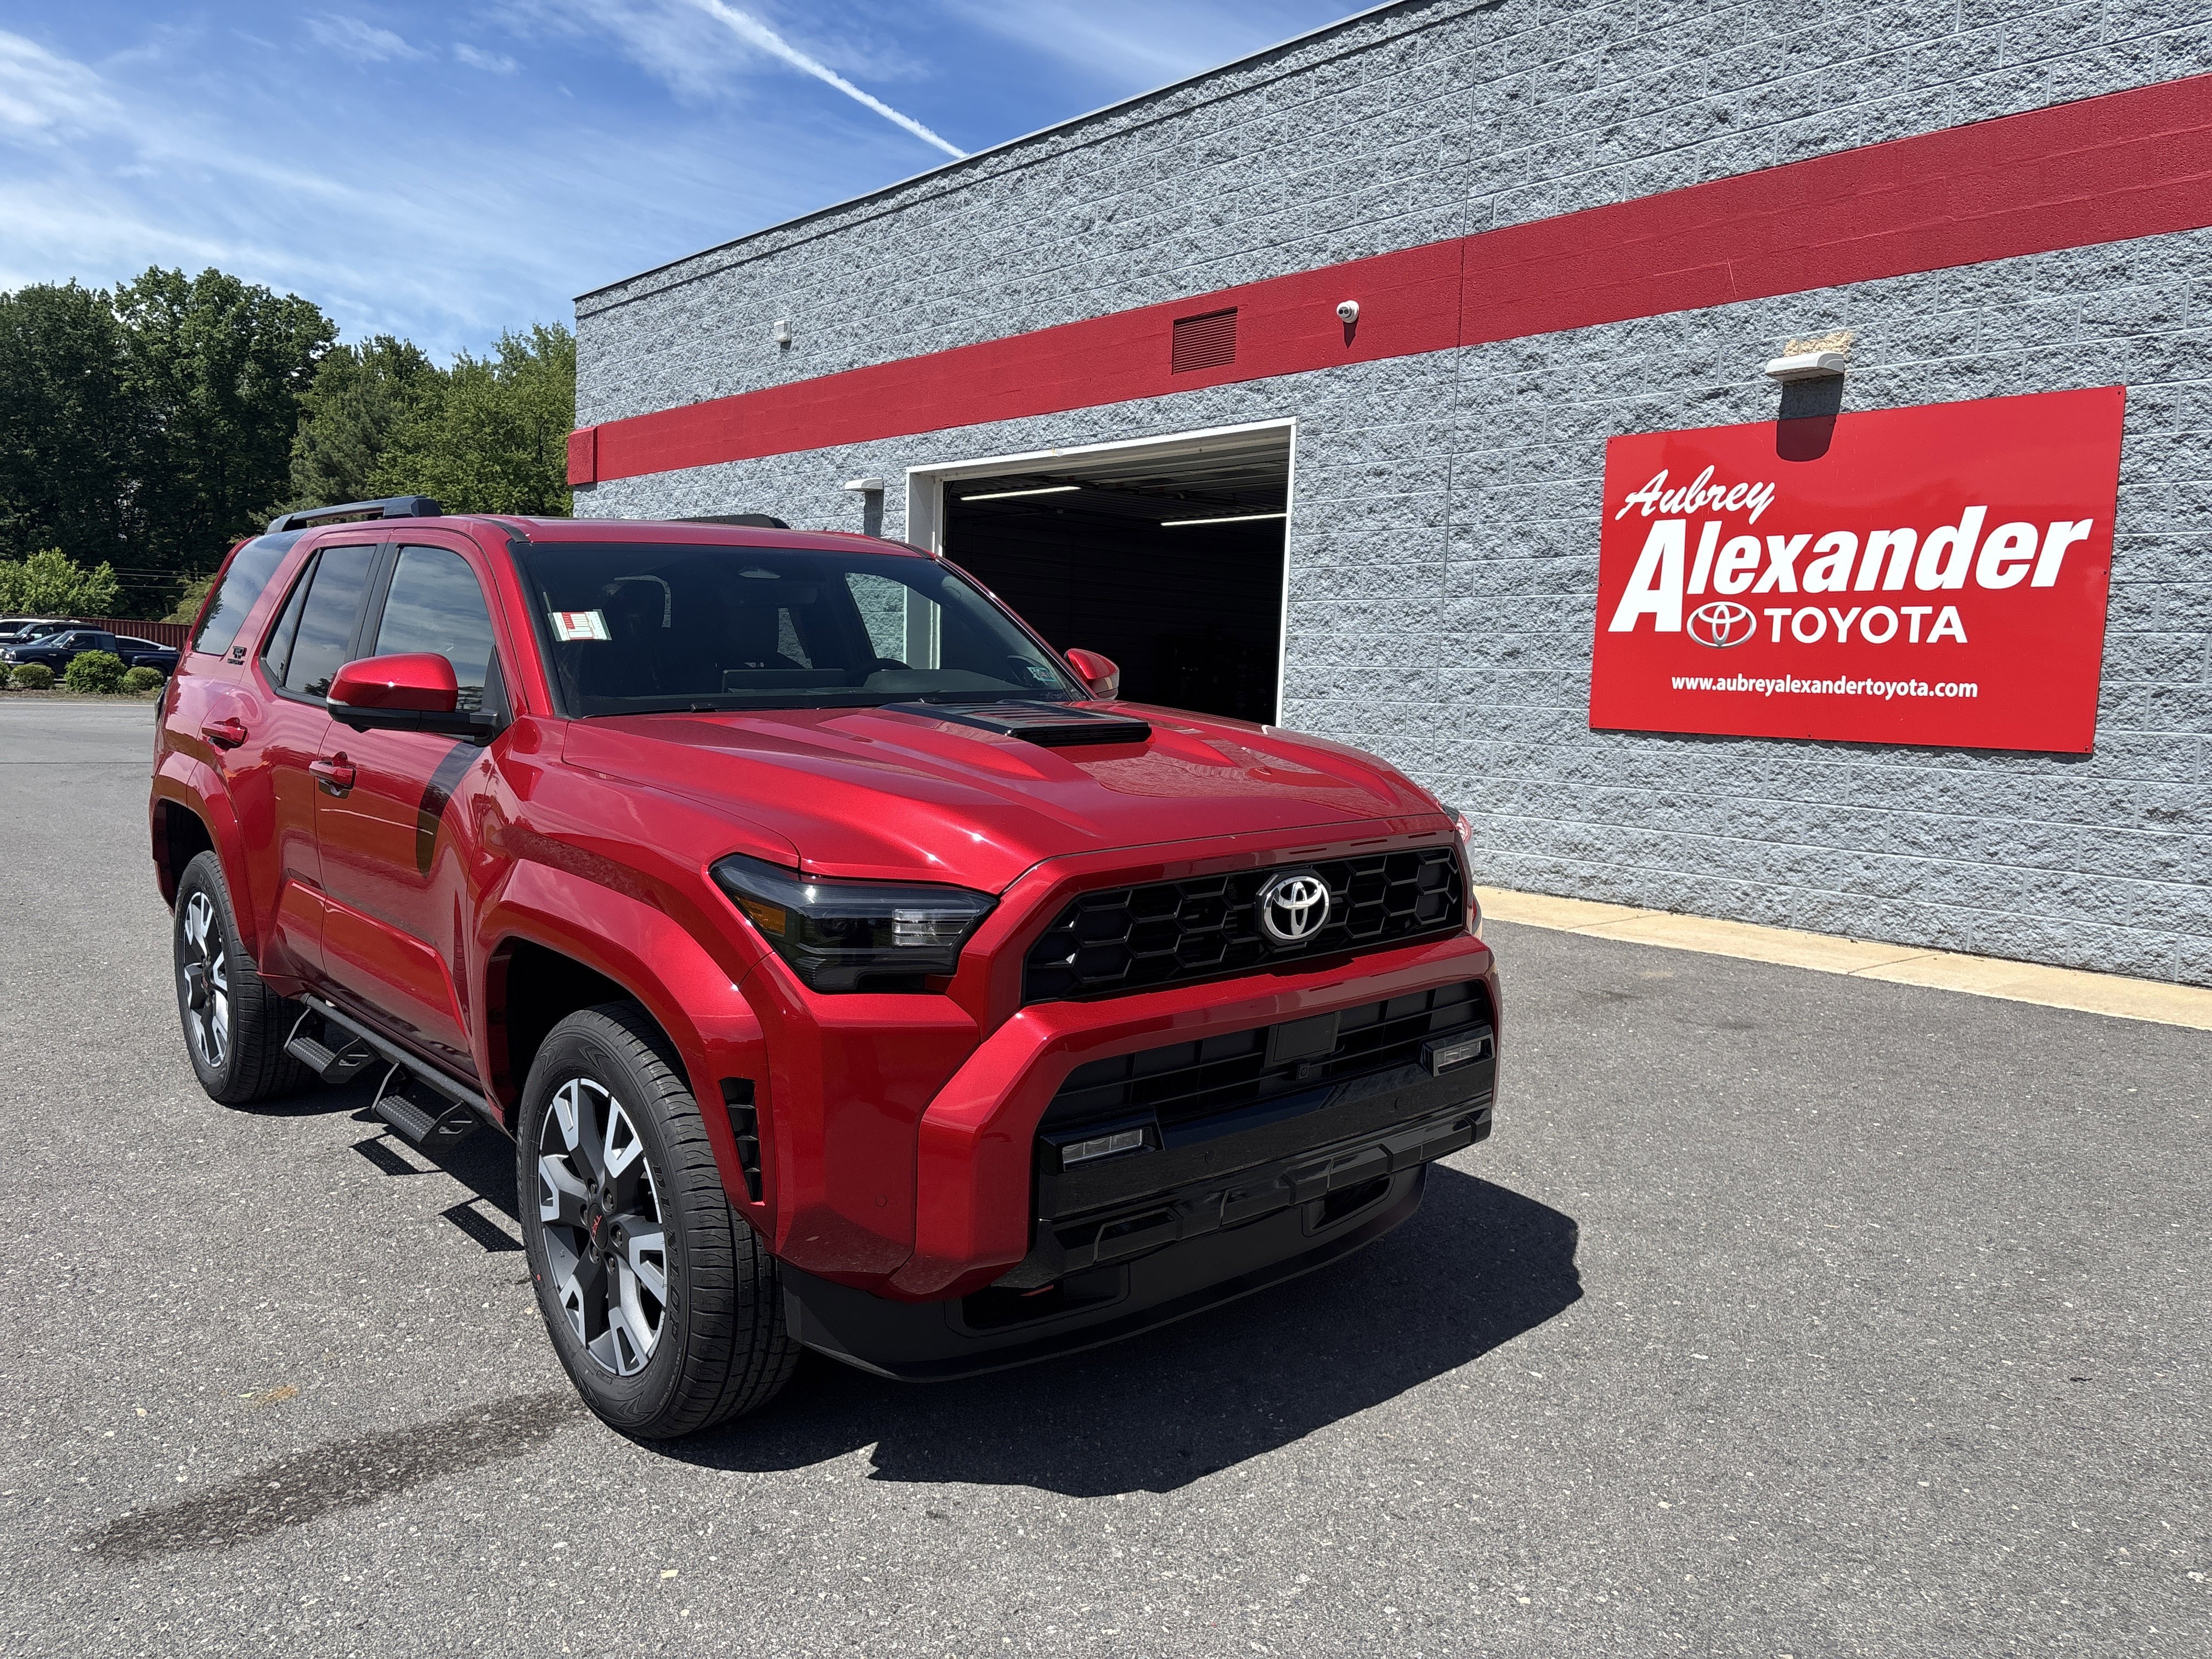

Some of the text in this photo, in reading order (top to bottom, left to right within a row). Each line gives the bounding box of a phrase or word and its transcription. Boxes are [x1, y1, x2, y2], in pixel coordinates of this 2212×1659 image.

[1615, 465, 1775, 525] Aubrey
[1607, 505, 2094, 632] Alexander
[1764, 605, 1968, 644] TOYOTA
[1671, 673, 1978, 701] www.aubreyalexandertoyota.com
[653, 1164, 681, 1344] DUNLOP
